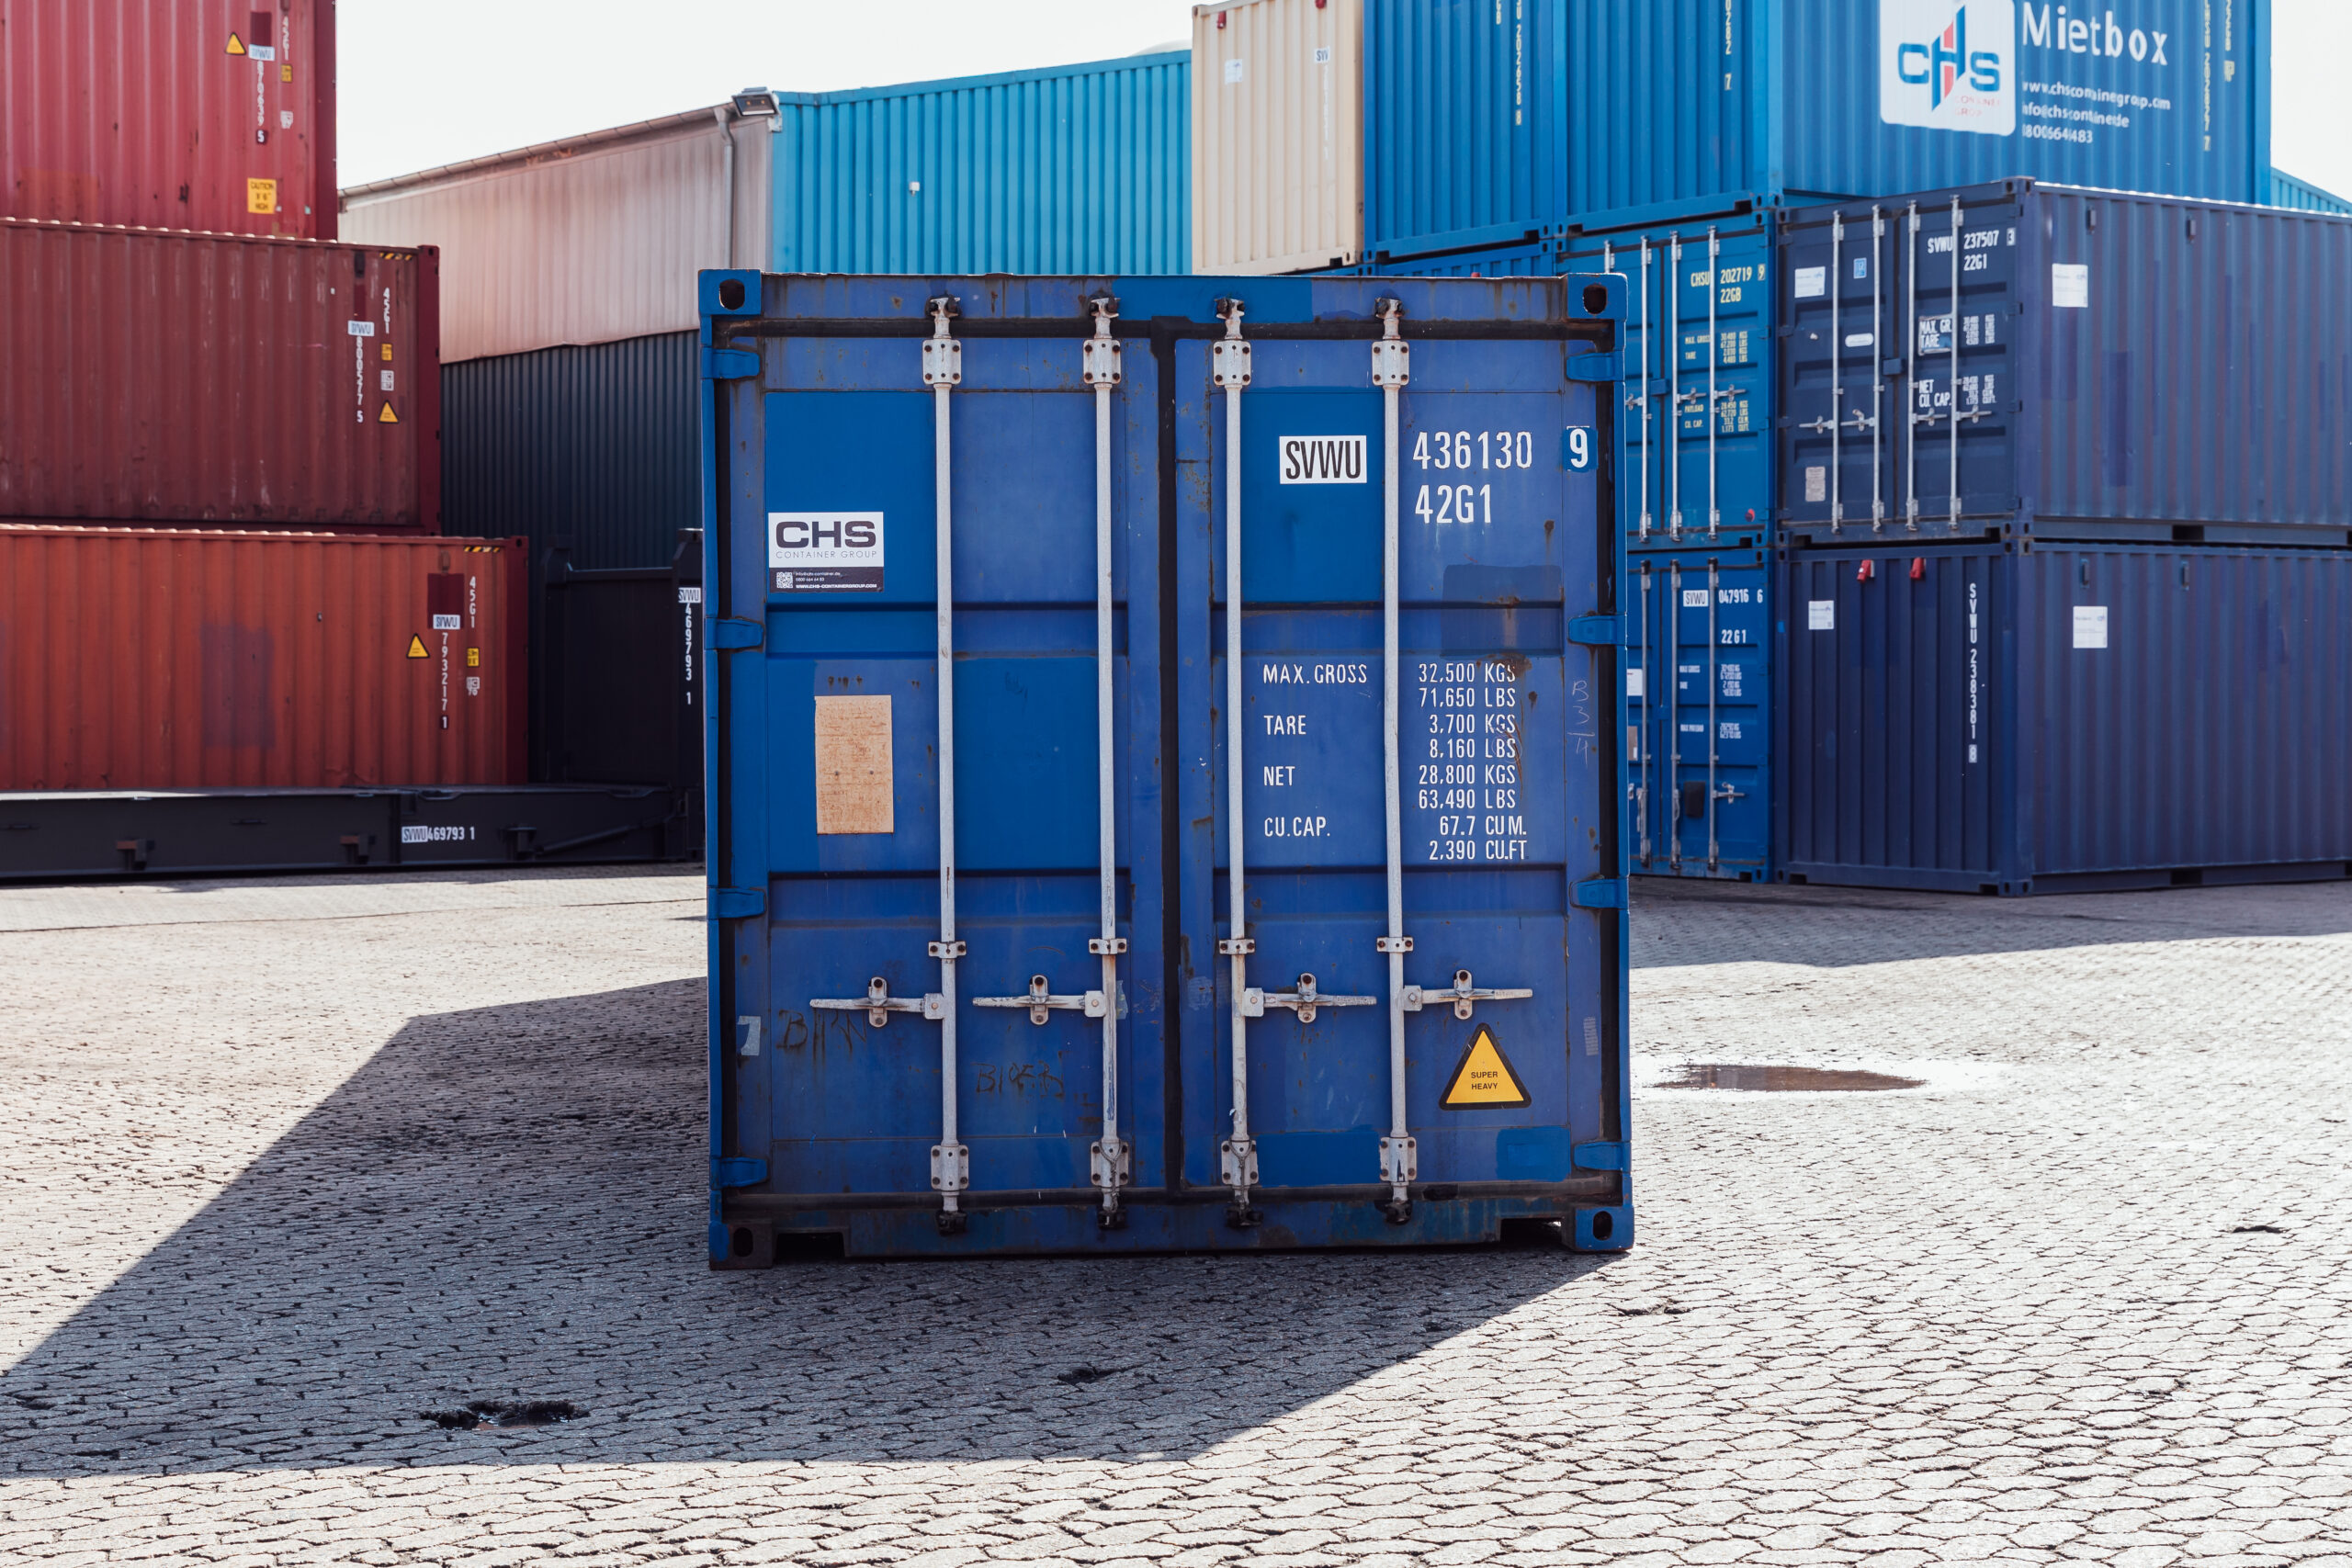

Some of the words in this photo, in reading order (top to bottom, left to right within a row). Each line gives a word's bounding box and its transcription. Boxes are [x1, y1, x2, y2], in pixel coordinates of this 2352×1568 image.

[2022, 3, 2168, 66] Mietbox
[258, 130, 265, 142] 5
[1928, 237, 1952, 254] SVWU
[1964, 230, 1999, 250] 237507
[2007, 231, 2015, 245] 3
[1964, 254, 1987, 271] 22G1
[1690, 272, 1710, 288] CHSU
[1721, 266, 1752, 284] 202719
[1758, 265, 1765, 280] 9
[1920, 333, 1940, 348] TARE
[1919, 379, 1934, 394] NET
[356, 411, 363, 423] 5
[1286, 440, 1362, 479] SVWU
[1413, 431, 1532, 469] 436130
[1570, 428, 1589, 468] 9
[1415, 484, 1491, 524] 42G1
[776, 521, 876, 548] CHS
[679, 589, 699, 602] SVWU
[1686, 592, 1706, 604] SVWU
[1719, 590, 1749, 604] 047916
[1757, 589, 1763, 604] 6
[1969, 582, 1977, 644] SVWU
[1263, 665, 1310, 683] MAX.
[1315, 664, 1367, 683] GROSS
[1419, 663, 1476, 682] 32,500
[1485, 663, 1516, 682] KGS
[686, 692, 691, 705] 1
[1419, 688, 1476, 707] 71,650
[1485, 688, 1516, 707] LBS
[442, 716, 447, 728] 1
[1263, 716, 1306, 735] TARE
[1430, 715, 1476, 734] 3,700
[1485, 715, 1516, 734] KGS
[1430, 739, 1476, 759] 8,160
[1485, 739, 1516, 759] LBS
[1970, 746, 1977, 761] 8
[1263, 766, 1295, 786] NET
[1419, 765, 1476, 784] 28,800
[1485, 765, 1516, 784] KGS
[1419, 790, 1476, 809] 63,490
[1485, 790, 1516, 809] LBS
[403, 827, 427, 841] SVWU
[427, 827, 465, 840] 469793
[469, 827, 475, 840] 1
[1440, 816, 1476, 836] 67.7
[1430, 840, 1476, 861] 2,390
[1471, 1071, 1498, 1079] SUPER
